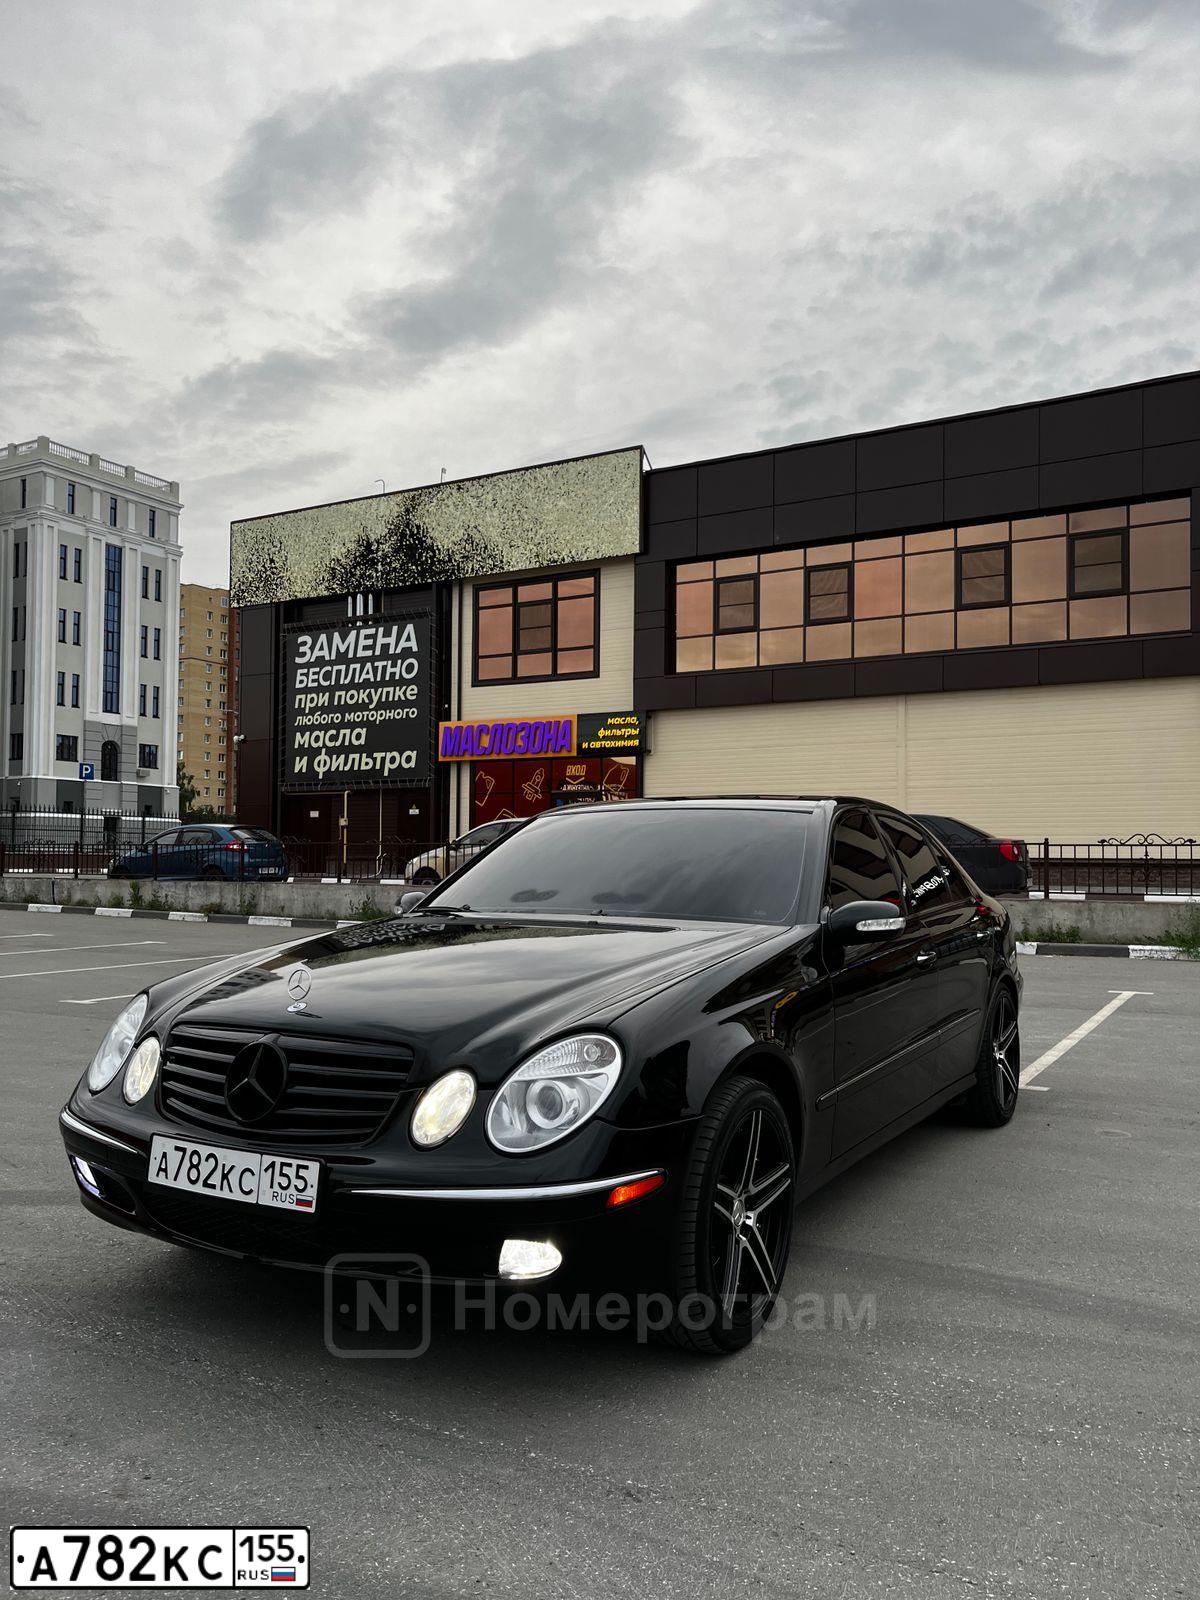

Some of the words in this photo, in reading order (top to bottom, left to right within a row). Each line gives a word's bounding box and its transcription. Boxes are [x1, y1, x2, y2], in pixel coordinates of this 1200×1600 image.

[295, 624, 419, 664] ЗАМЕНА
[295, 658, 419, 688] БЕСПЛАТНО
[295, 692, 329, 713] при
[334, 684, 418, 709] покупке
[294, 711, 342, 726] любого
[344, 708, 418, 724] моторного
[608, 717, 639, 725] масла,
[294, 728, 367, 749] масла
[441, 720, 572, 757] МАСЛОЗОНА
[598, 728, 639, 738] фильтры
[590, 740, 639, 748] автохимия
[83, 765, 91, 777] P
[294, 756, 308, 773] и
[313, 748, 417, 779] фильтра
[566, 765, 586, 776] ВХОД
[156, 1145, 256, 1196] А782КС
[264, 1161, 308, 1193] 155
[272, 1191, 295, 1204] RUS
